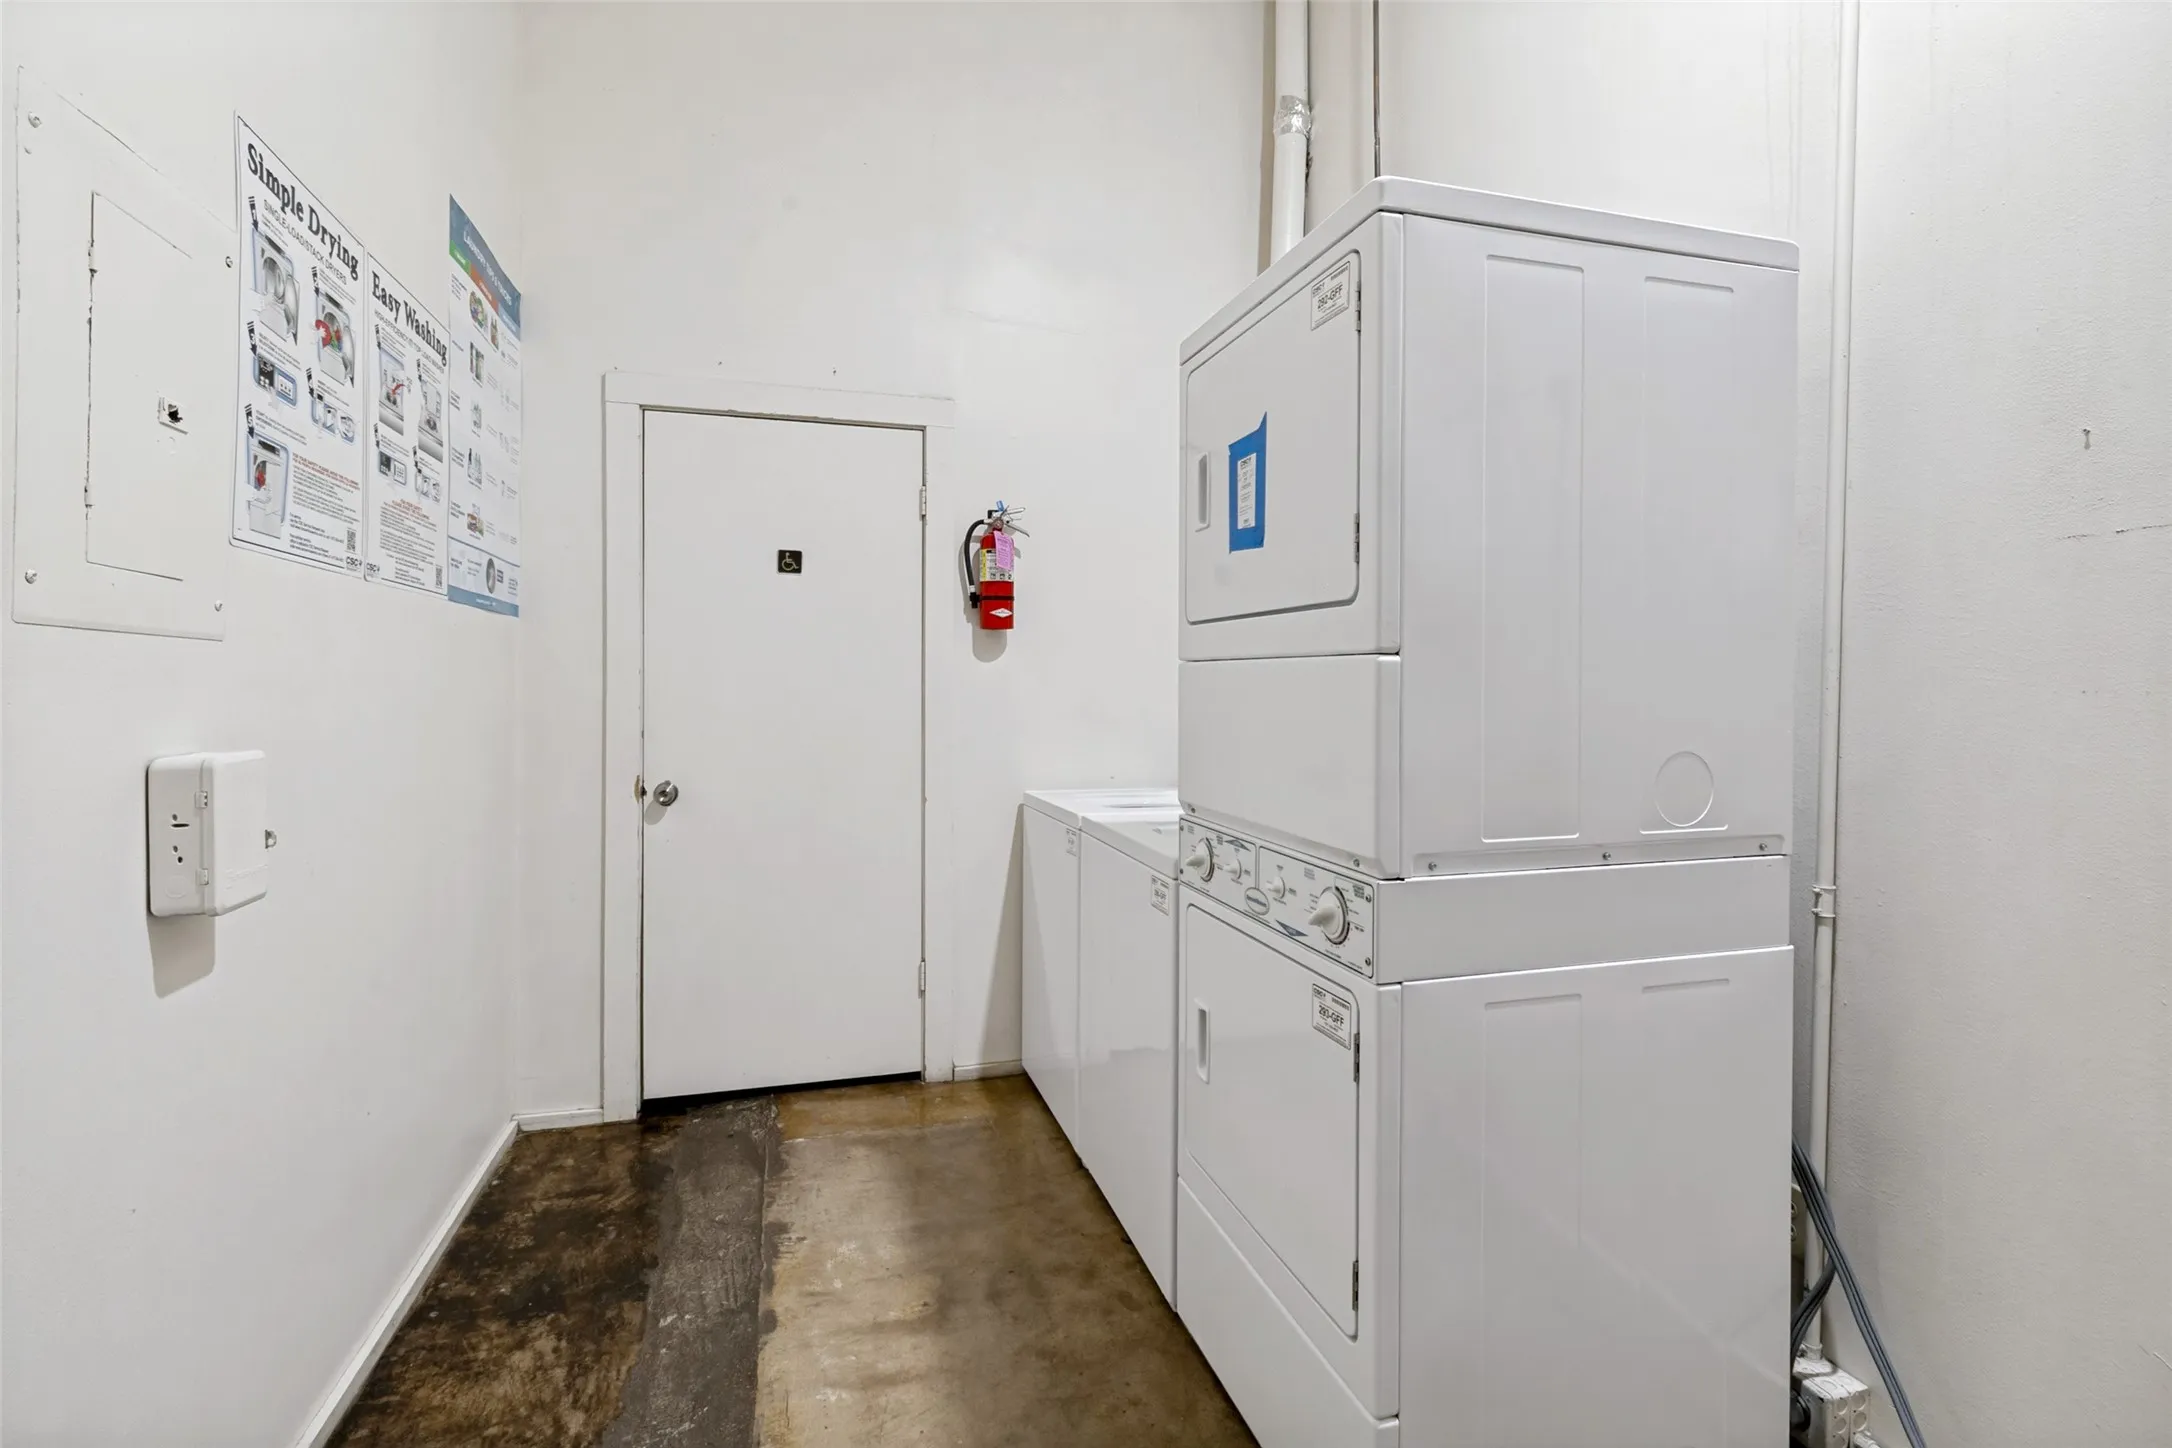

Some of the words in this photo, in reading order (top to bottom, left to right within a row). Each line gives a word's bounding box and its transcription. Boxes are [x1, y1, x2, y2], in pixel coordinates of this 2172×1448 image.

[247, 143, 304, 222] Simple
[307, 204, 359, 281] Drying
[324, 258, 348, 285] DRYERS
[372, 270, 401, 324] Easy
[403, 299, 447, 367] Washing
[345, 556, 359, 567] CSC
[366, 562, 377, 573] CSC
